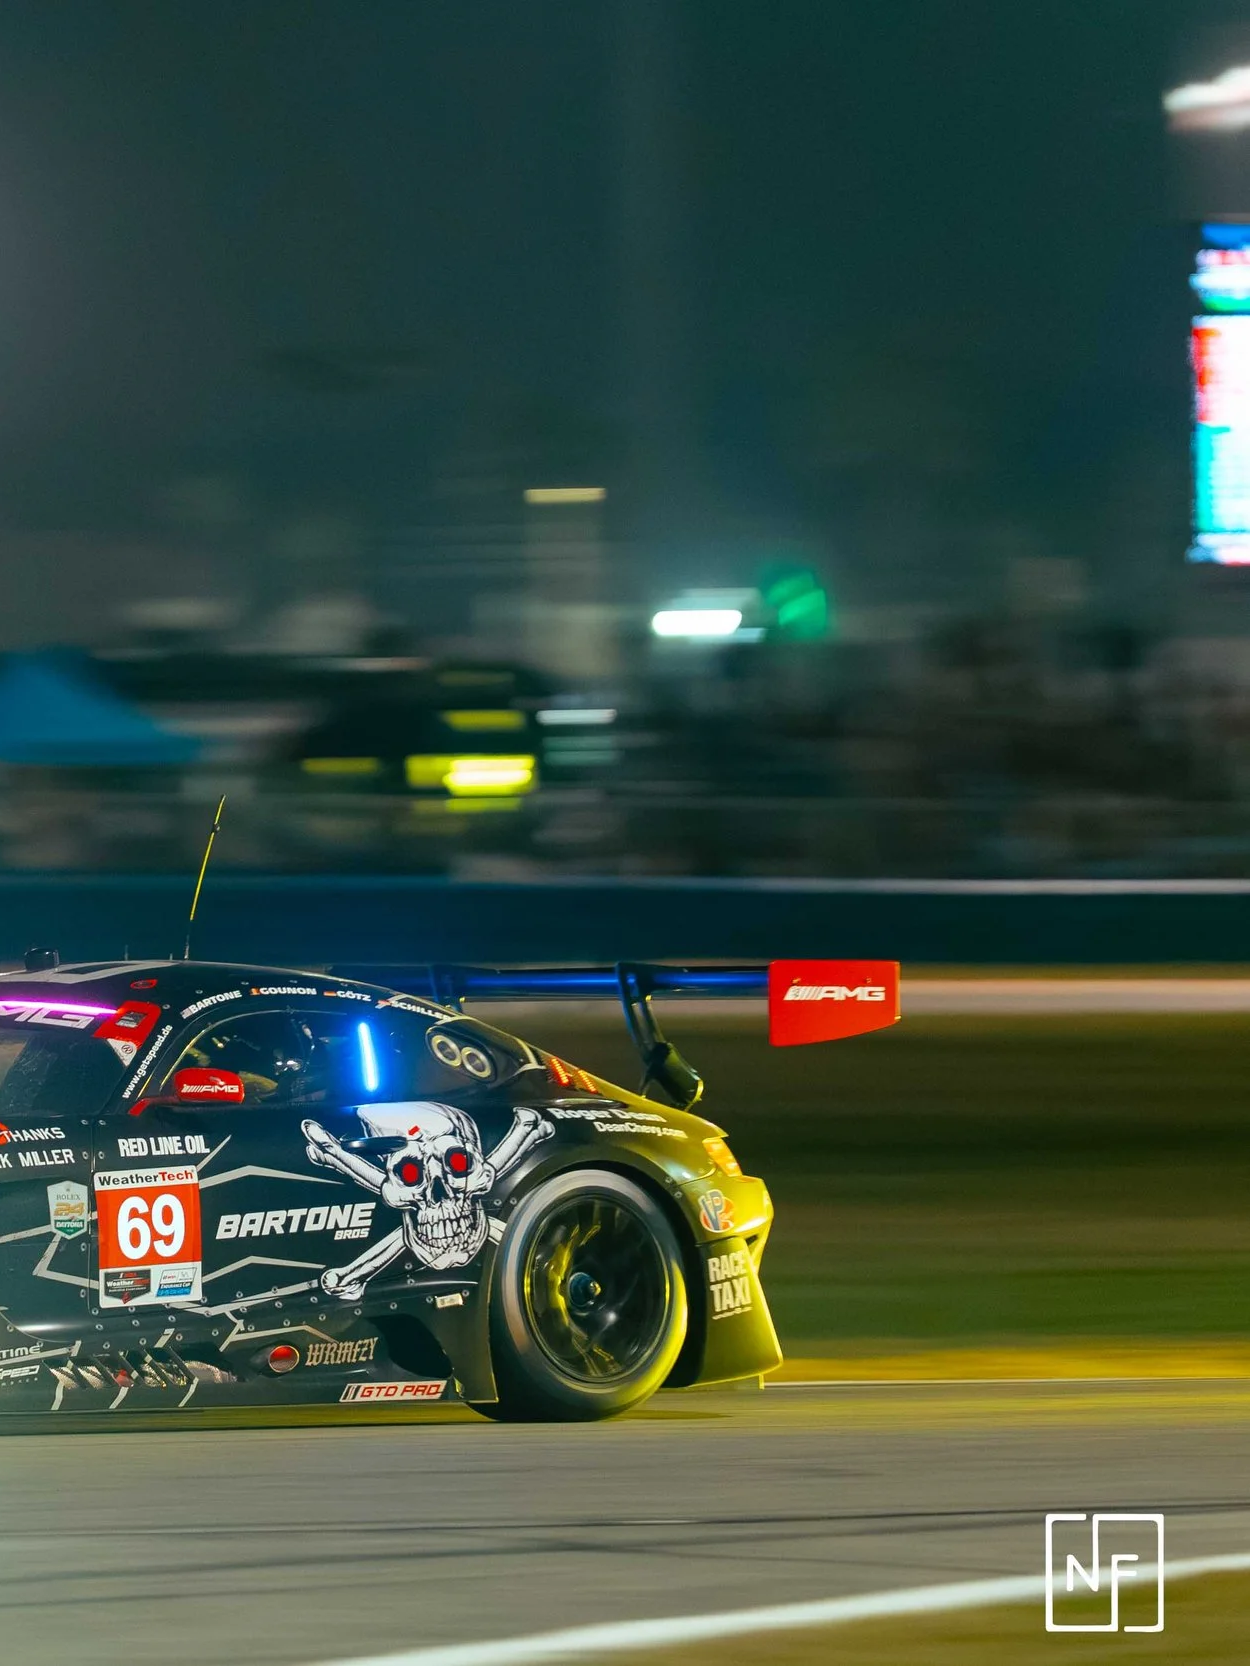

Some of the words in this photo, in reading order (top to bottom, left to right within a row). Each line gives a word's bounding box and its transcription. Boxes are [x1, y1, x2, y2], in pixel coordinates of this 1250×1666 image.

[259, 987, 317, 996] GOUNON
[337, 990, 371, 1001] GÖTZ
[816, 986, 885, 1001] AMG
[189, 990, 242, 1014] BARTONE
[121, 1024, 173, 1100] www.getspeed.de
[547, 1108, 612, 1120] Roger
[1, 1126, 66, 1142] THANKS
[118, 1138, 148, 1157] RED
[185, 1135, 210, 1154] OIL
[20, 1149, 76, 1168] MILLER
[98, 1169, 194, 1187] WeatherTech
[117, 1193, 186, 1260] 69
[216, 1202, 376, 1240] BARTONE
[334, 1228, 370, 1240] BROS
[708, 1250, 746, 1283] RACE
[710, 1277, 752, 1312] TAXI
[360, 1385, 398, 1398] GTD
[401, 1384, 441, 1397] PRO
